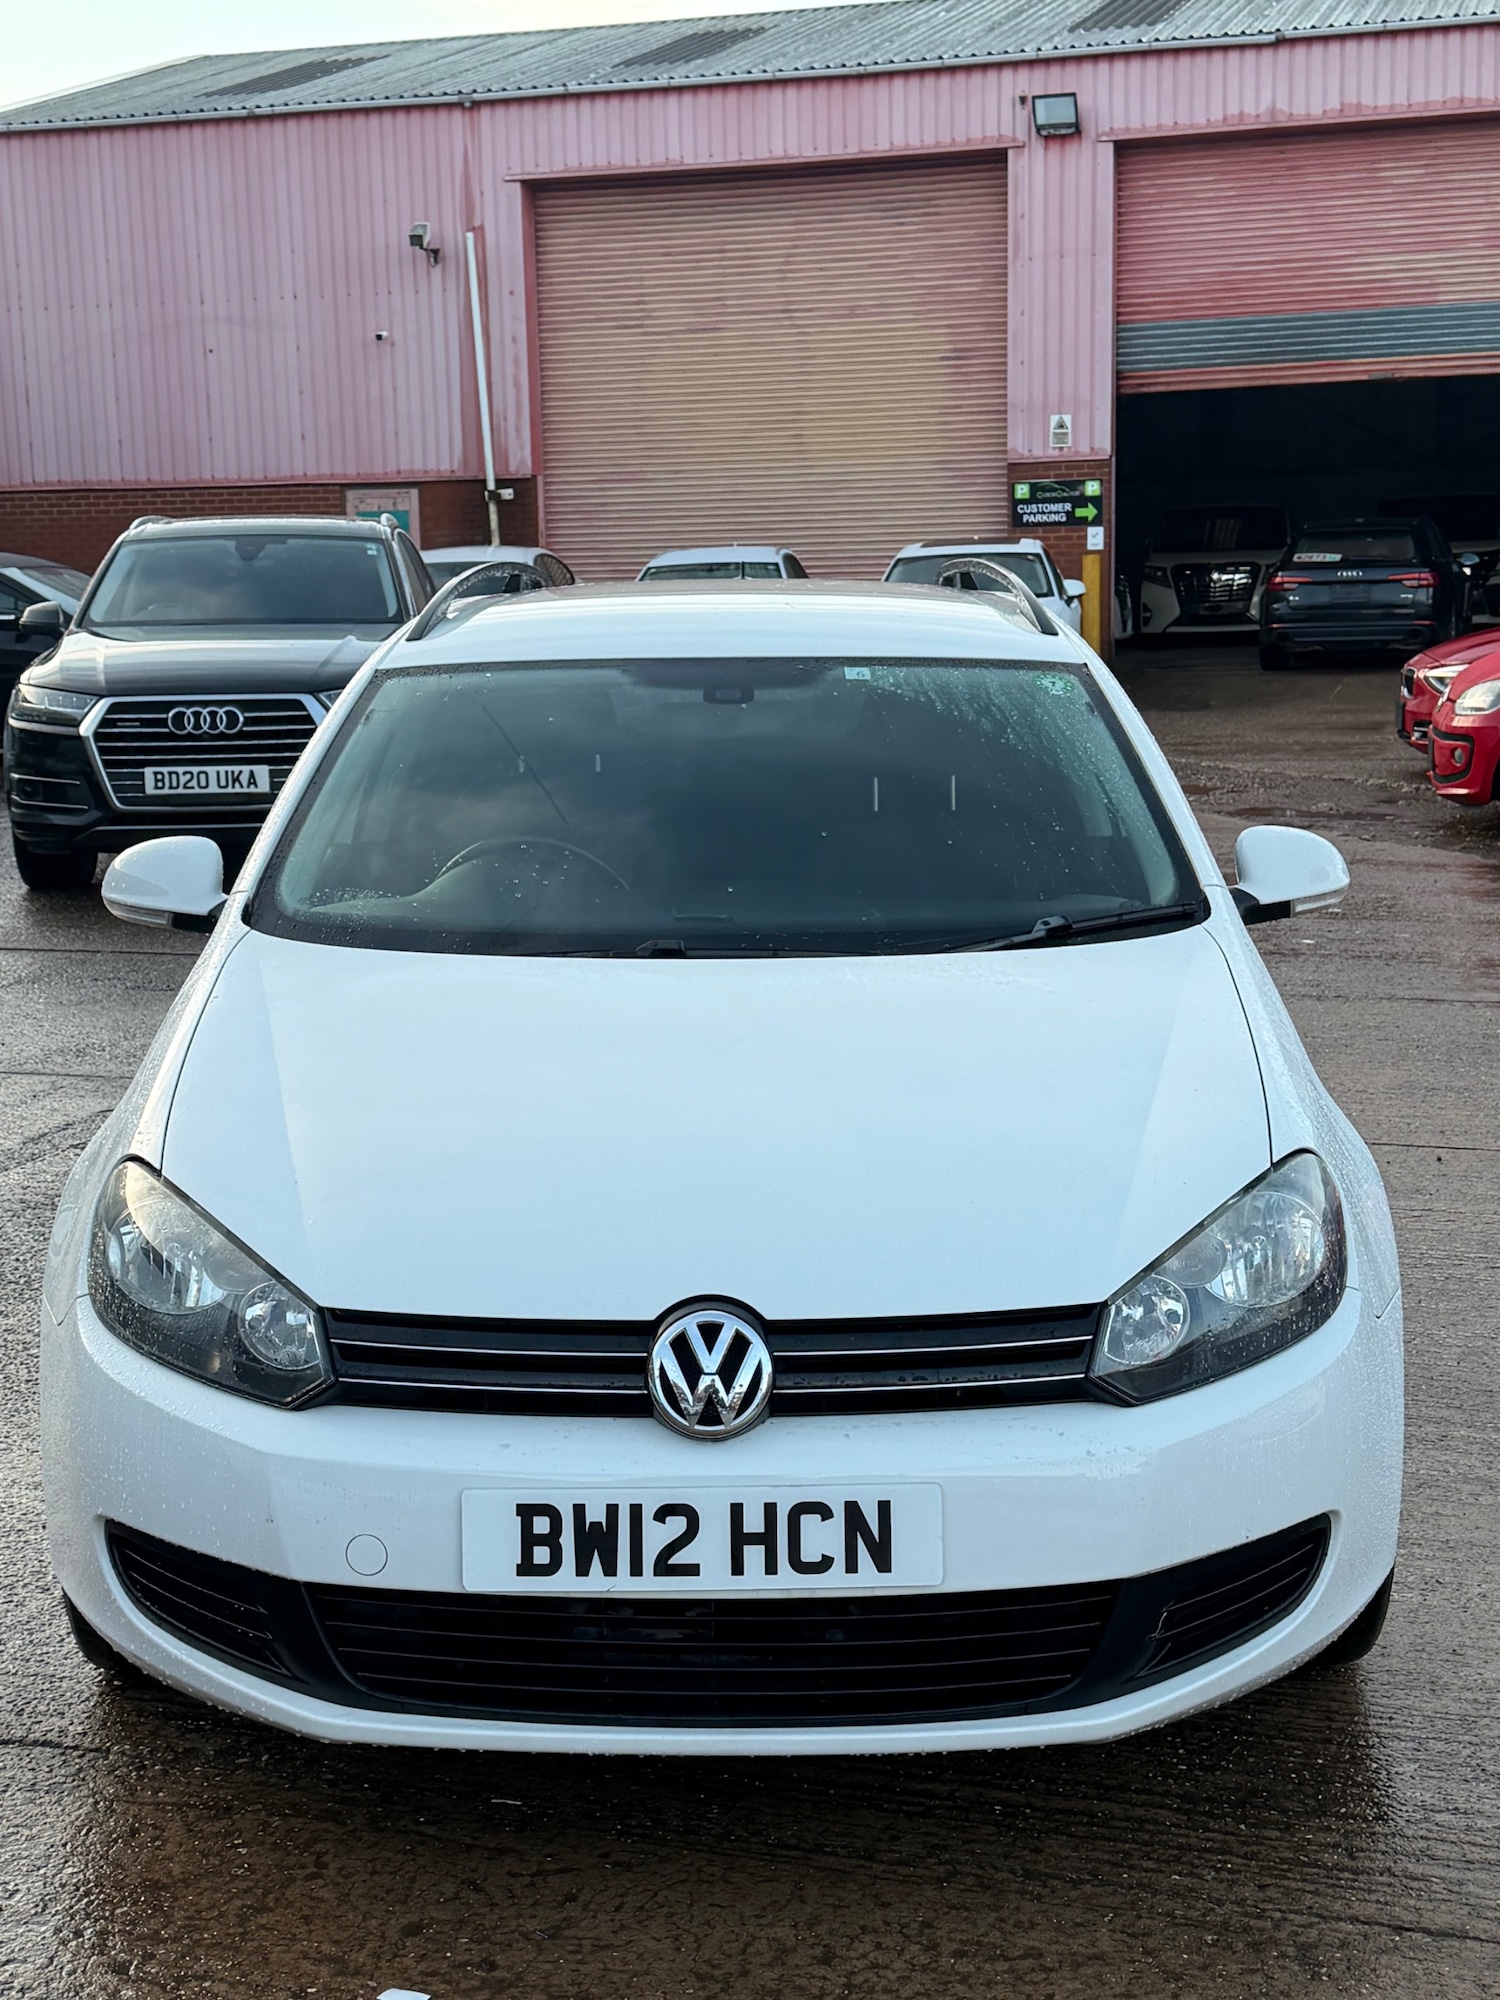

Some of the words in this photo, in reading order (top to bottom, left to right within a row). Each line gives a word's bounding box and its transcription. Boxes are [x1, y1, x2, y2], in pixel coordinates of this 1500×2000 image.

[1017, 503, 1072, 514] CUSTOMER
[1022, 513, 1067, 523] PARKING
[152, 770, 209, 790] BD20
[216, 769, 258, 789] UKA
[652, 1314, 769, 1434] VW
[515, 1502, 701, 1578] BW12
[730, 1500, 892, 1576] HCN
